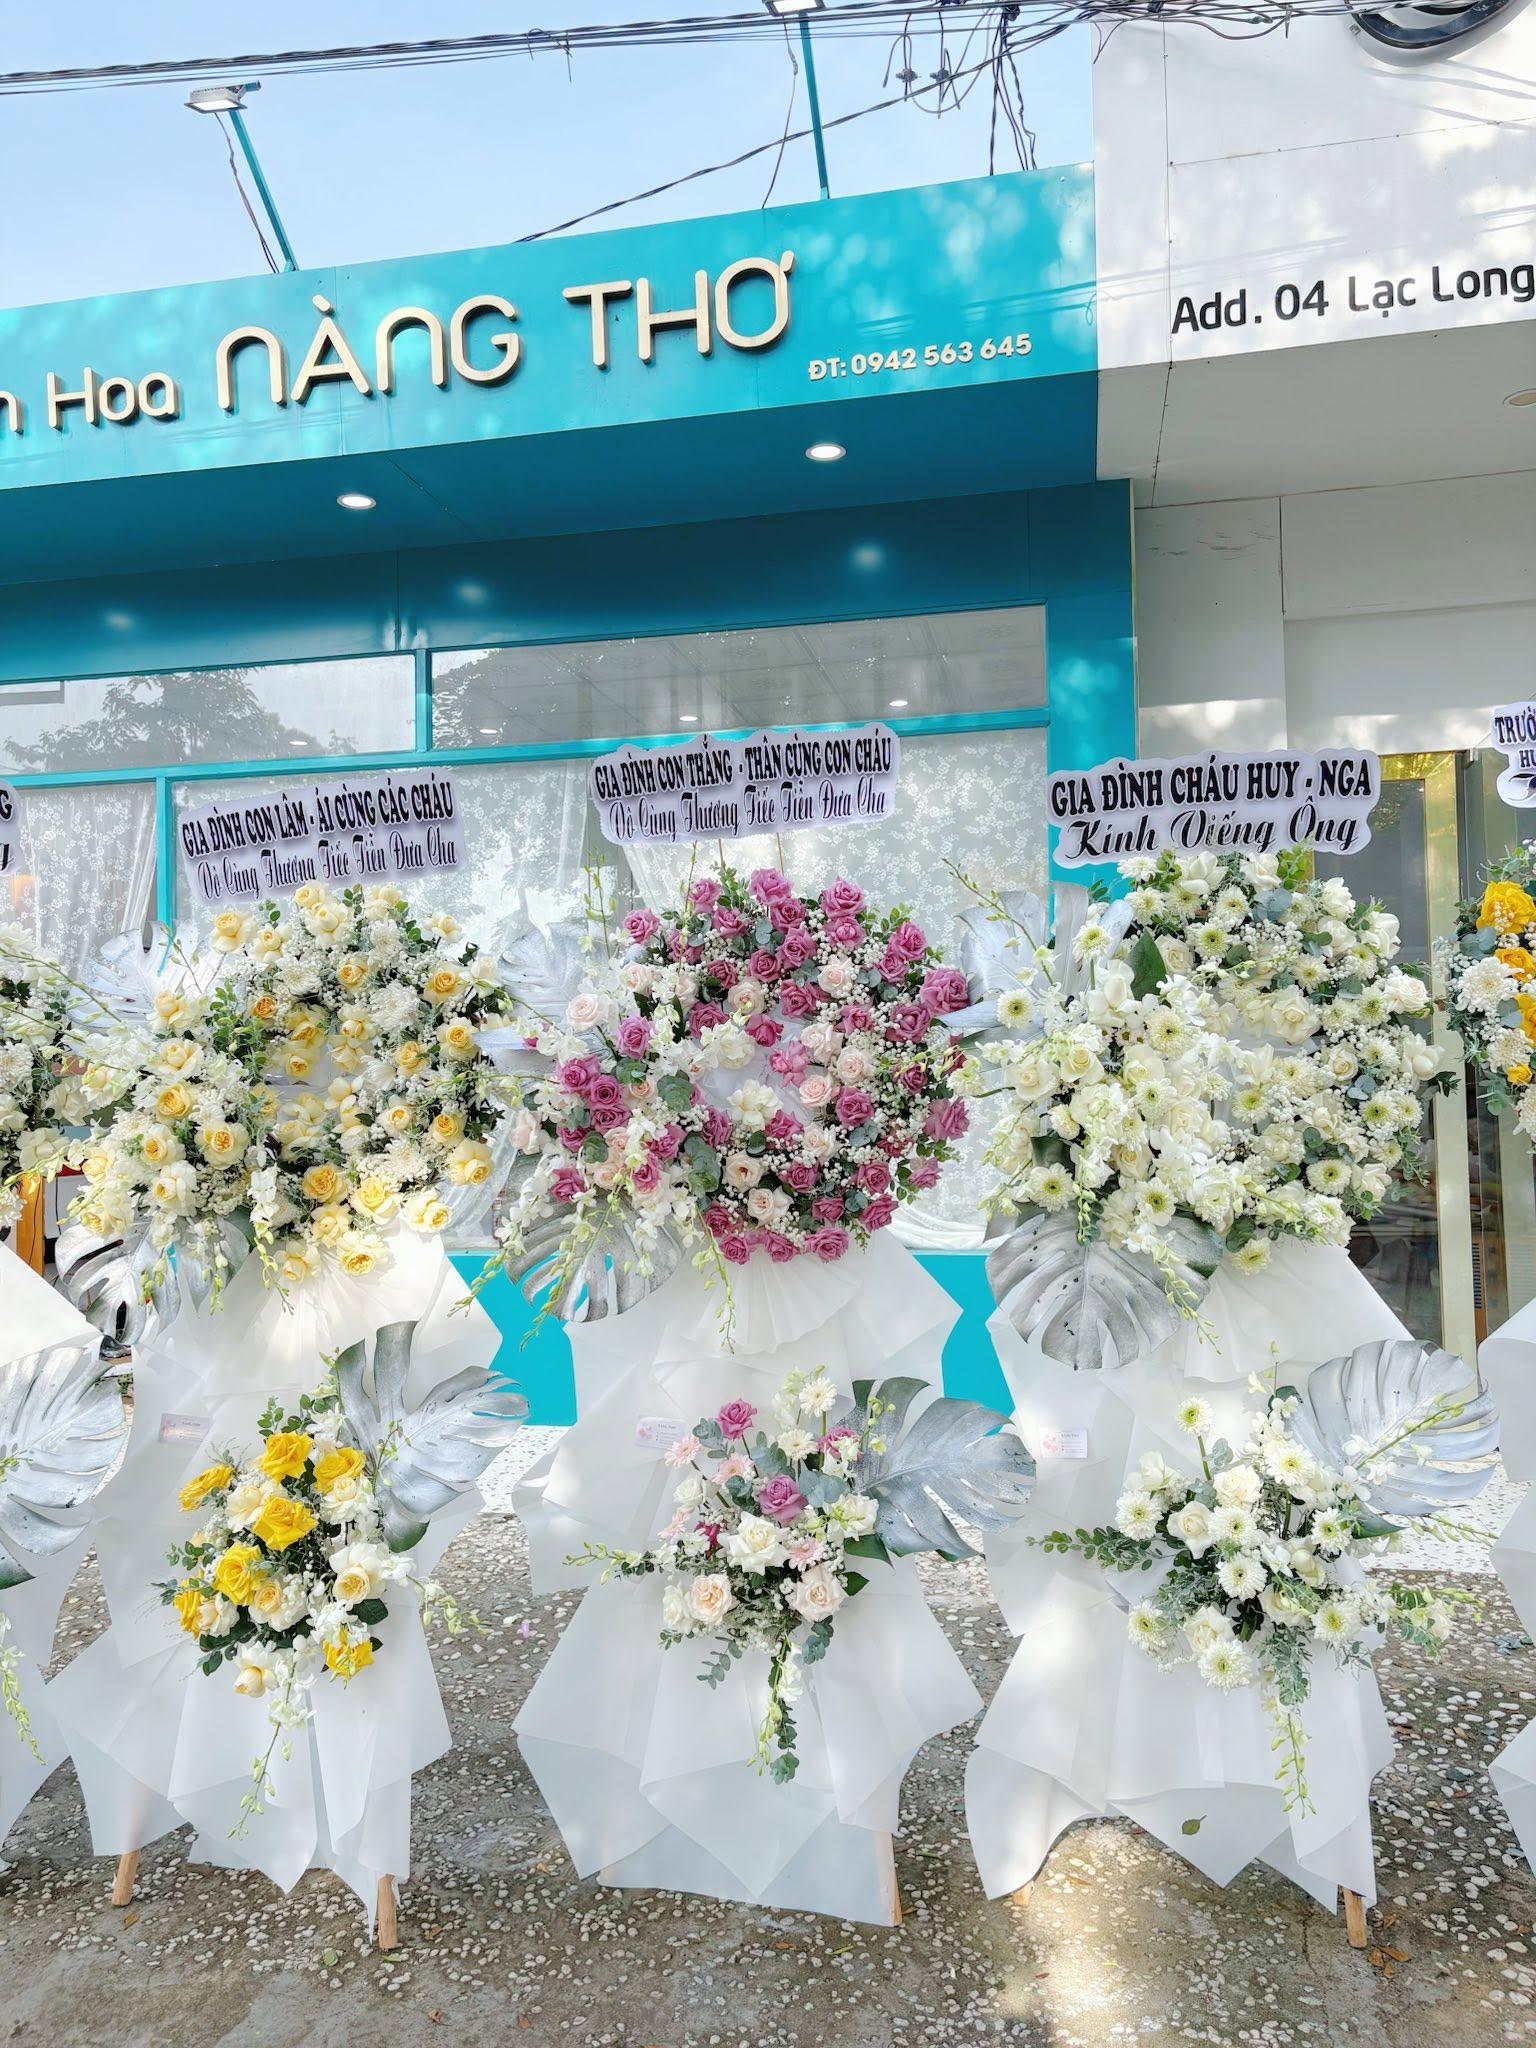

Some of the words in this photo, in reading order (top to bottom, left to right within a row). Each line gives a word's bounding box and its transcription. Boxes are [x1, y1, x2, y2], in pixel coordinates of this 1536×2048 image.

[1274, 280, 1329, 320] 04
[1348, 276, 1416, 318] Lạc
[1432, 264, 1536, 302] Long
[47, 367, 179, 431] Hoa
[563, 250, 795, 370] THƠ
[808, 356, 846, 380] ĐT:
[851, 348, 917, 375] 0942
[924, 341, 973, 366] 563
[979, 333, 1032, 360] 645
[595, 764, 622, 799] GIA
[620, 752, 656, 796] ĐÌNH
[657, 755, 686, 791] CON
[745, 735, 783, 781] THÂN
[785, 733, 821, 777] CÙNG
[824, 739, 851, 774] CON
[855, 728, 891, 773] CHÁU
[1052, 777, 1096, 817] GIA
[1101, 762, 1163, 811] ĐÌNH
[1170, 754, 1239, 804] CHÁU
[1247, 761, 1299, 799] HUY
[1319, 759, 1372, 797] NGA
[182, 820, 210, 857] GIA
[207, 806, 246, 852] ĐÌNH
[245, 805, 277, 844] CON
[274, 792, 309, 839] LÂM
[334, 783, 376, 830] CÙNG
[378, 777, 410, 824] CÁC
[411, 772, 453, 820] CHÁU
[639, 797, 676, 842] Cùng
[681, 791, 740, 836] Thương
[819, 779, 851, 819] Đưa
[857, 777, 885, 815] Cha
[1065, 815, 1158, 859] Kính
[1170, 810, 1275, 853] Viếng
[1289, 795, 1358, 851] Ông
[223, 856, 260, 899] Cùng
[389, 831, 424, 870] Đưa
[427, 825, 457, 866] Cha
